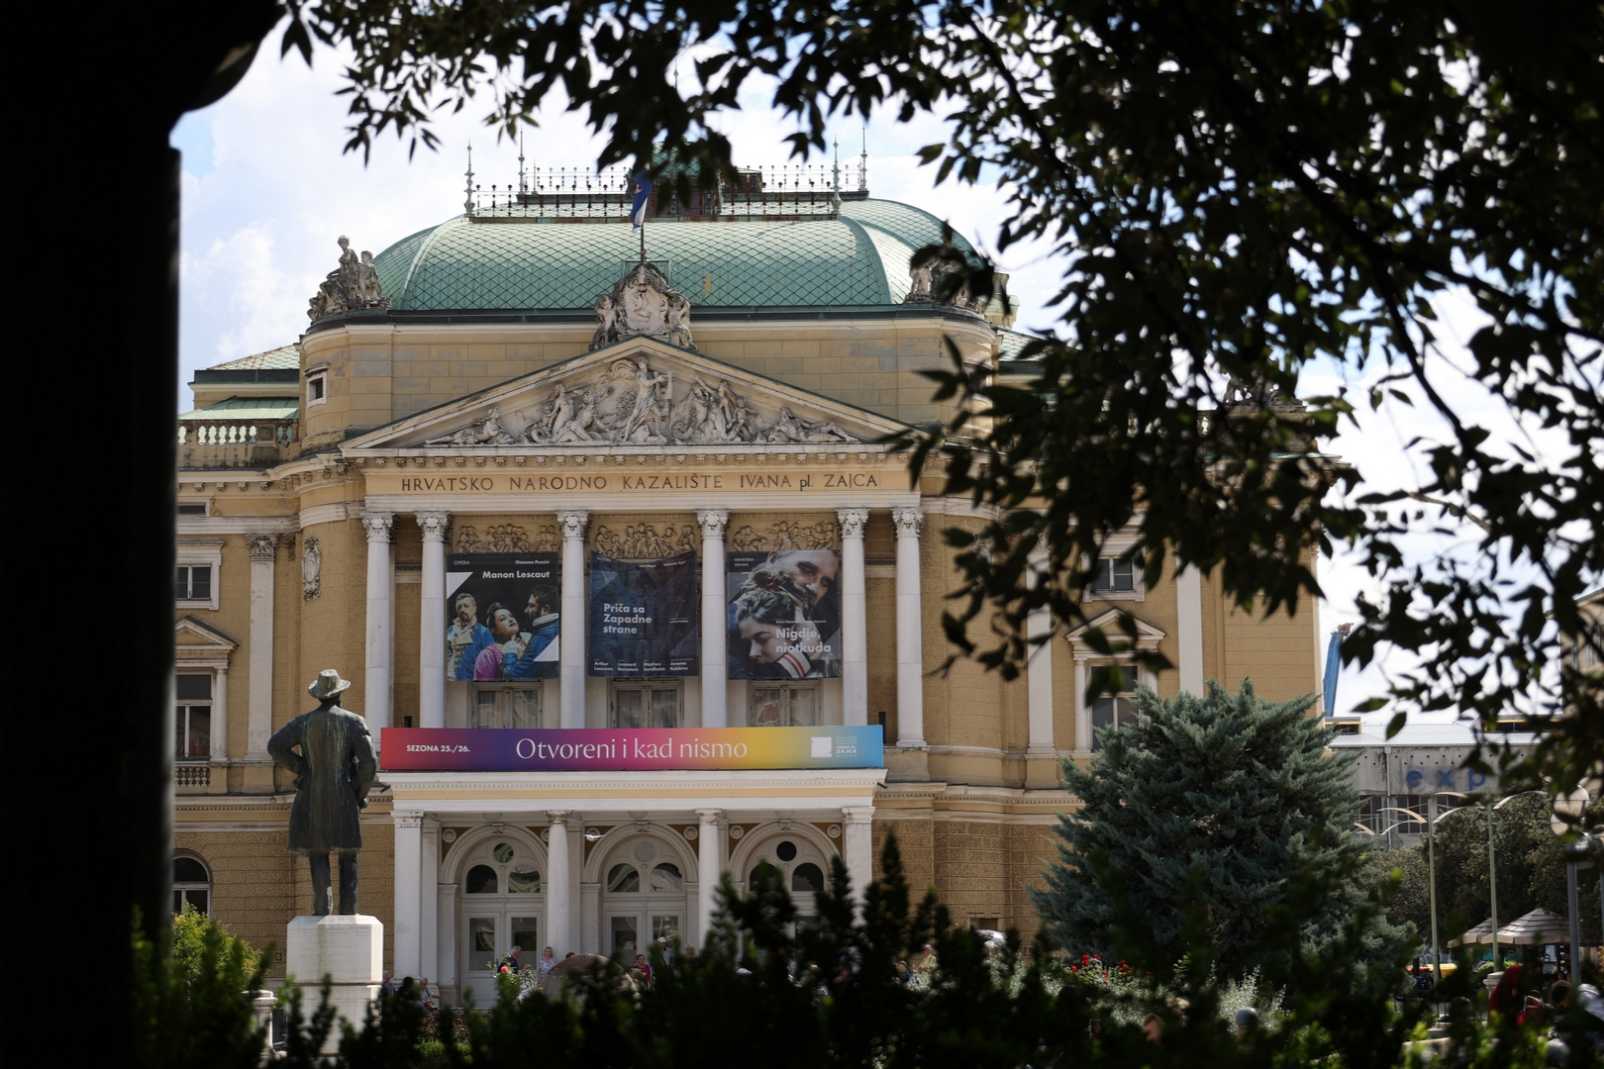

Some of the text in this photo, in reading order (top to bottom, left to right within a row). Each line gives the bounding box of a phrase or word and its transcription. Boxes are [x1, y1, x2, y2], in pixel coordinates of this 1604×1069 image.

[401, 476, 494, 491] HRVATSKO
[509, 475, 608, 490] NARODNO
[623, 473, 723, 489] KAZALIŠTE
[740, 474, 792, 489] IVANA
[823, 473, 878, 488] ZAJCA
[482, 570, 550, 579] Manon Lescaut
[603, 603, 630, 613] Priča
[603, 614, 652, 625] Zapadne
[603, 625, 637, 634] strane
[406, 744, 439, 752] SEZONA
[515, 737, 748, 759] Otvoreni i kad nismo
